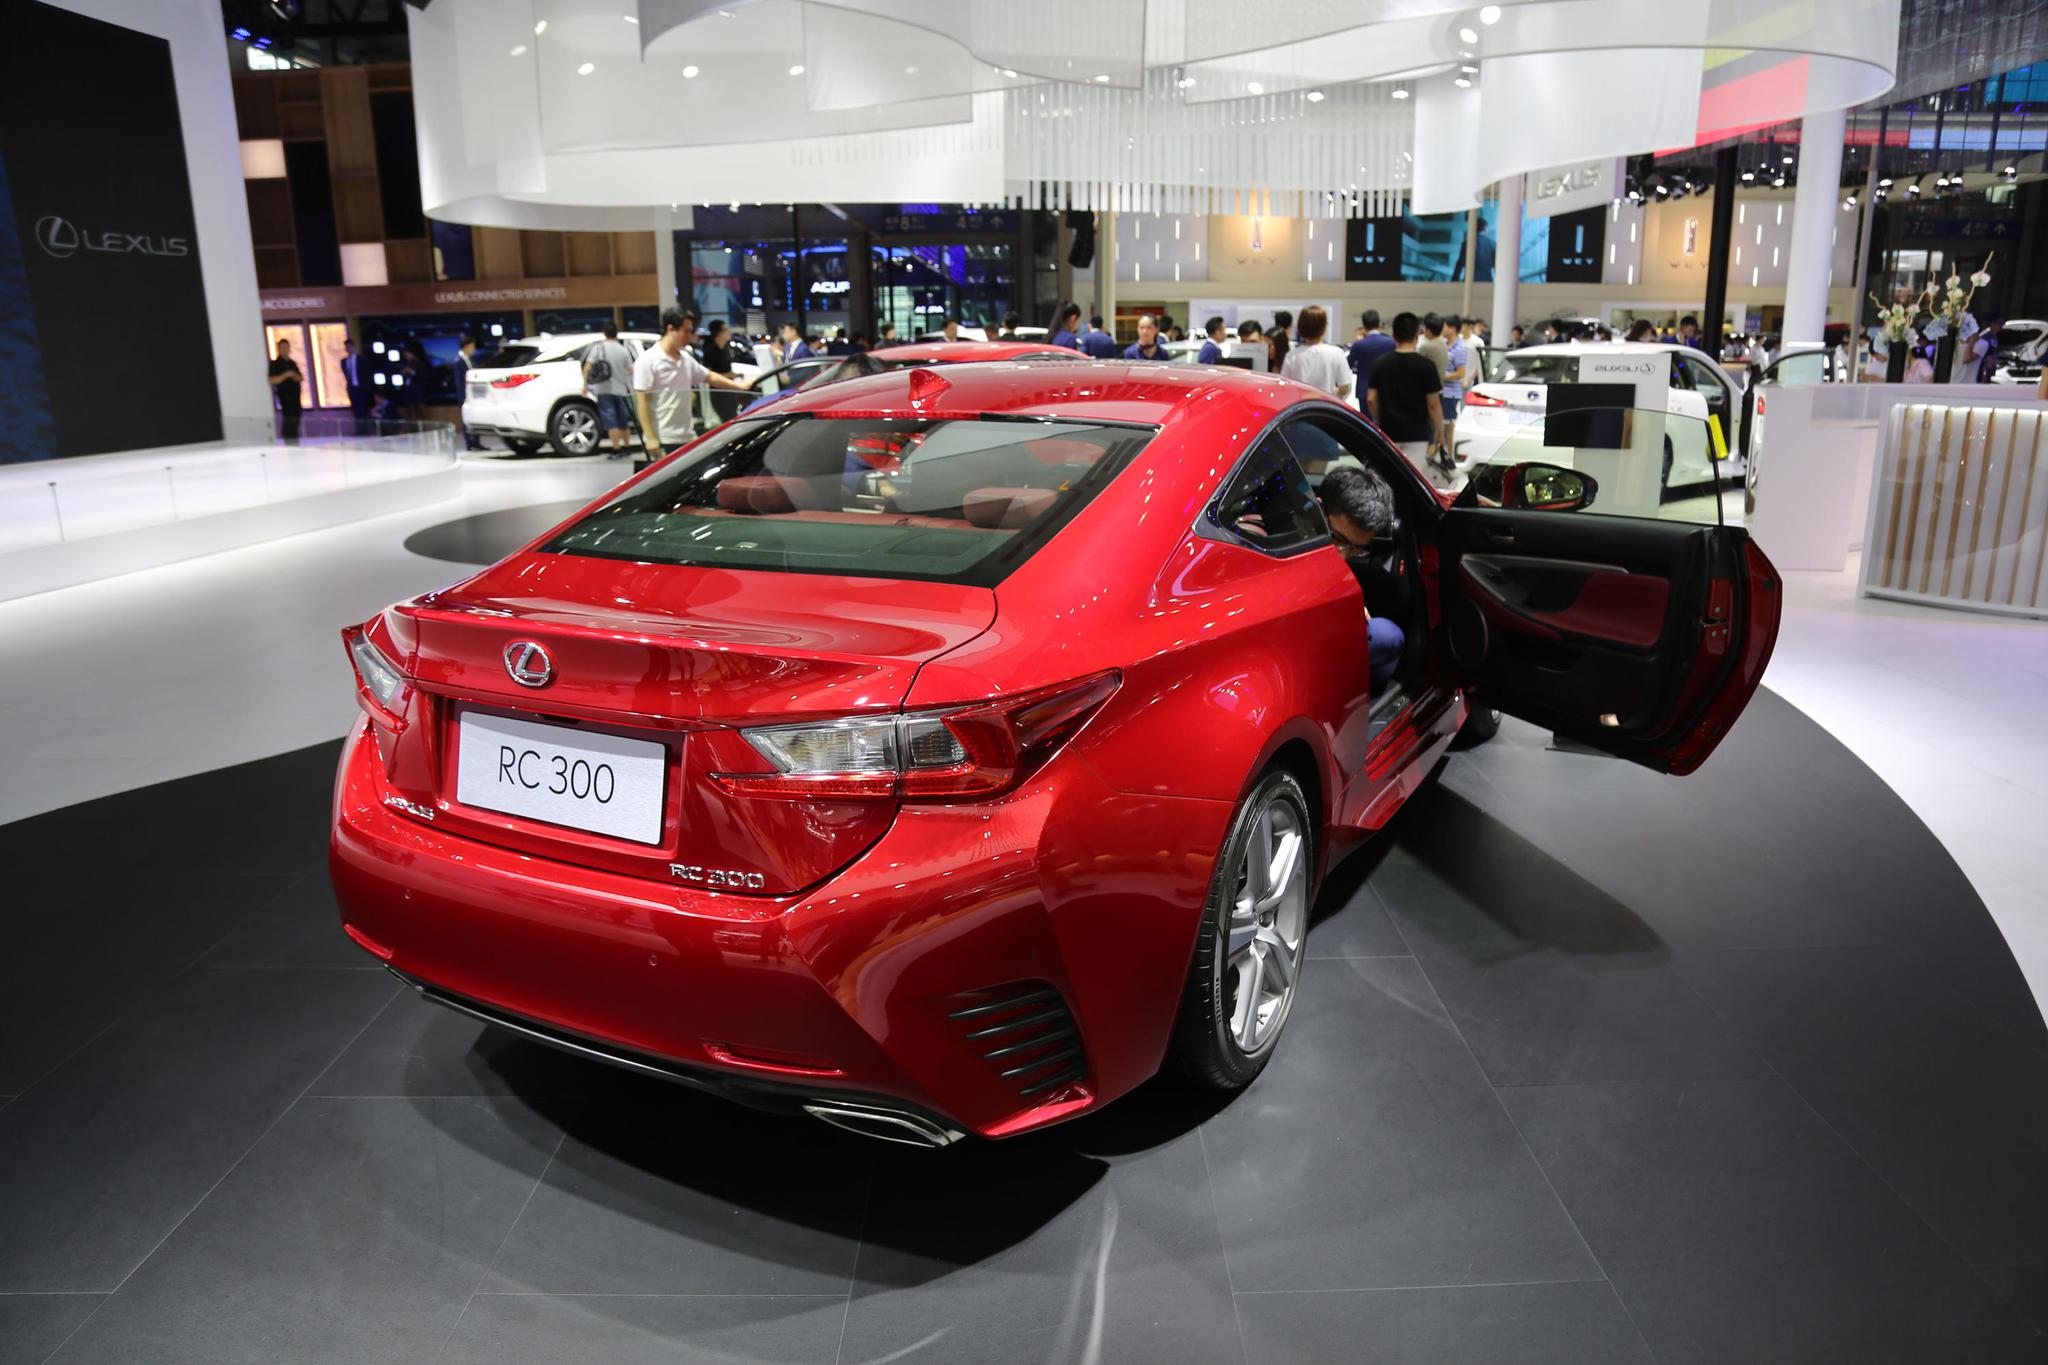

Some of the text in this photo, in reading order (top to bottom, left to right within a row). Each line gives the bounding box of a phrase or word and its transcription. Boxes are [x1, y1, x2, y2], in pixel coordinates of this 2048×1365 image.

[82, 229, 188, 256] LEXUS
[1353, 255, 1386, 264] WEY
[1562, 257, 1594, 265] WEY
[499, 745, 615, 804] RC 300
[669, 863, 765, 889] RC 300
